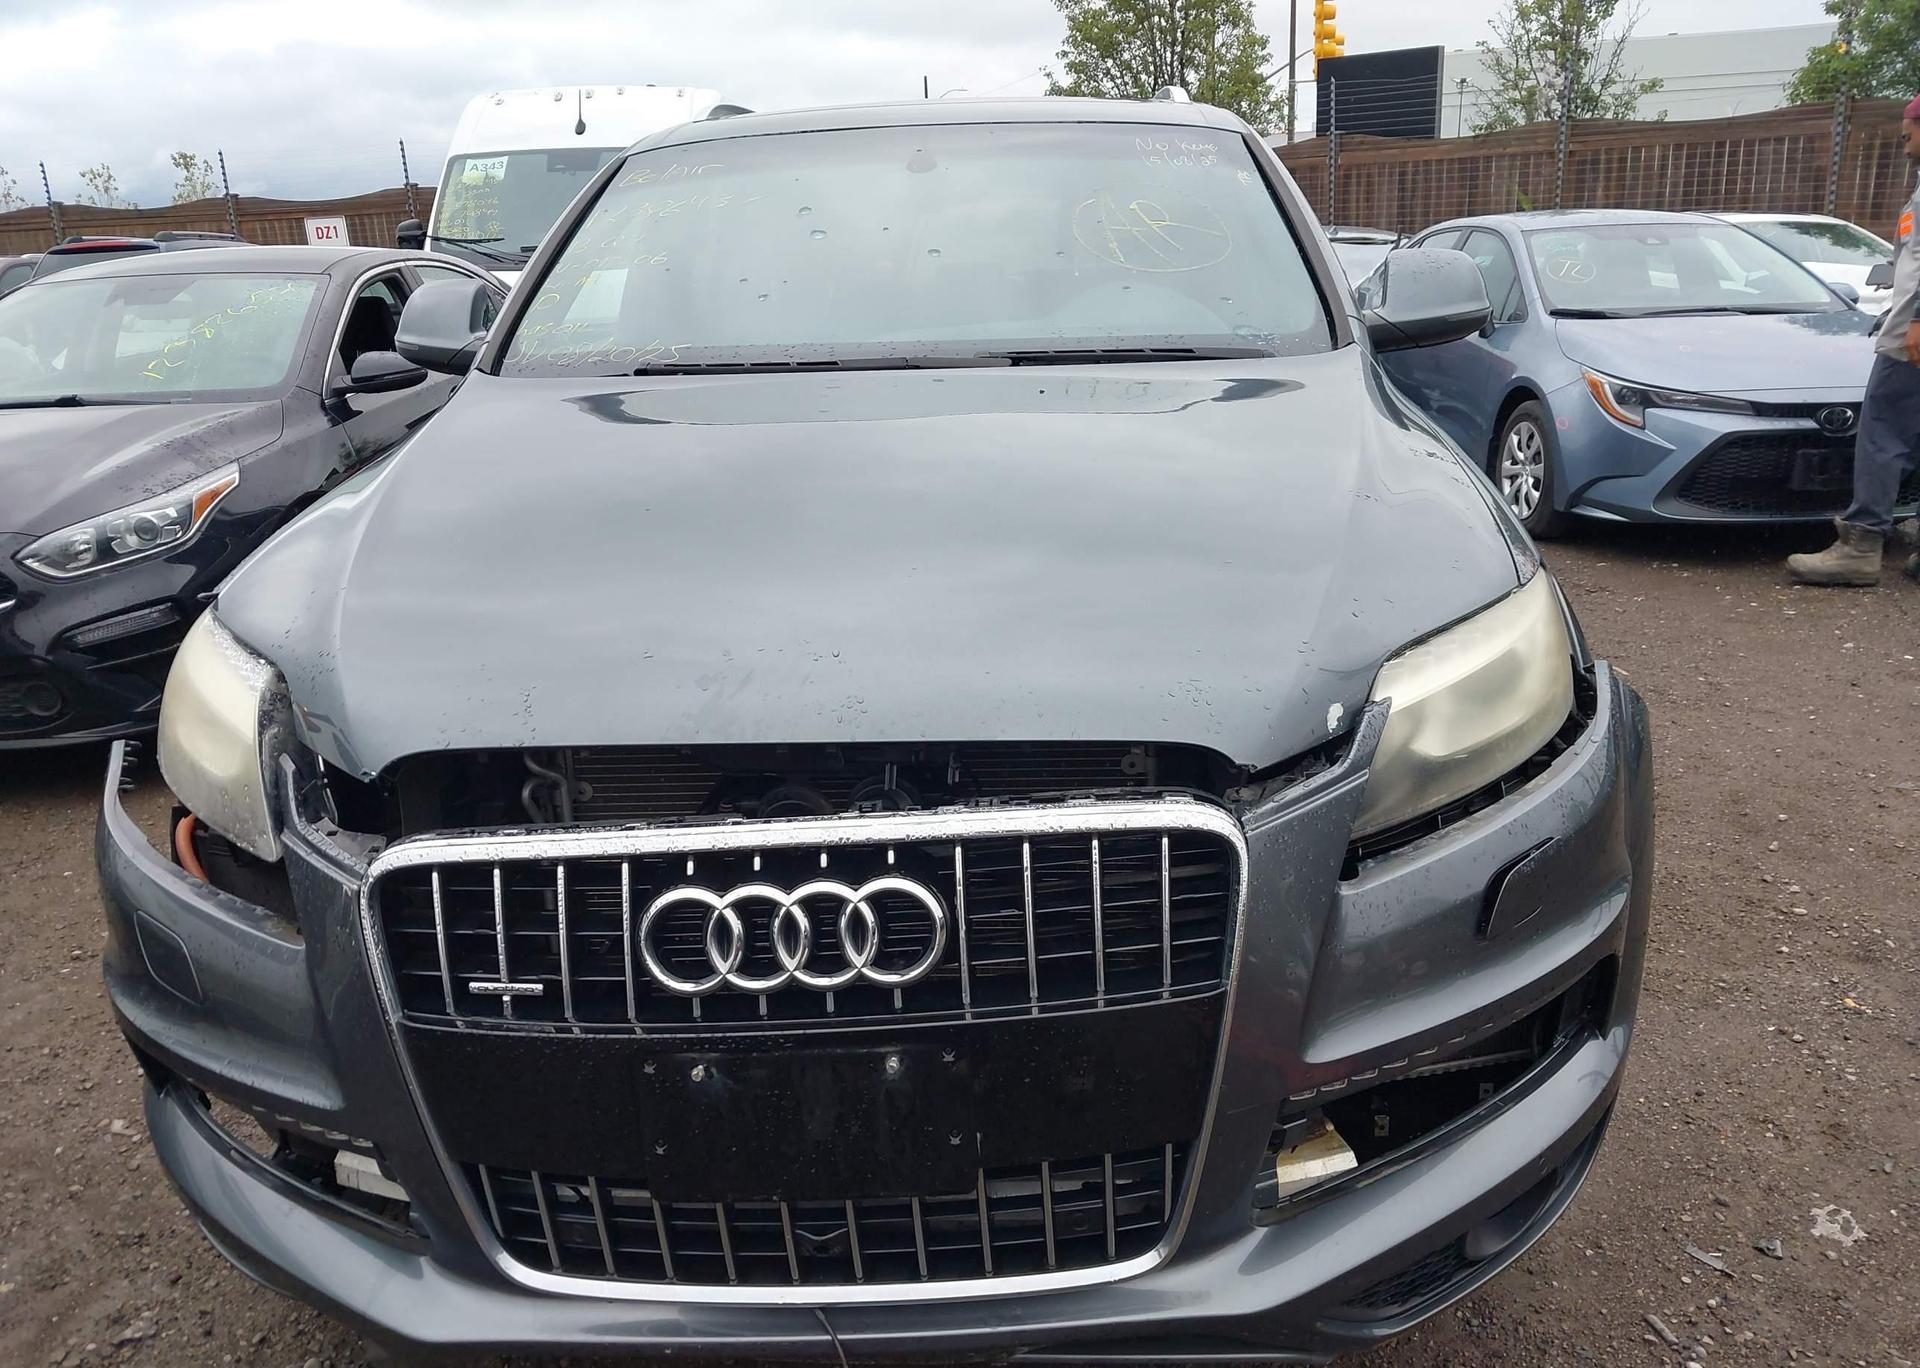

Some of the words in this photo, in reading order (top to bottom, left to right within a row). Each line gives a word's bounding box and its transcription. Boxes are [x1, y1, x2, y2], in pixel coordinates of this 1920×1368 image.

[469, 161, 505, 173] A343
[315, 225, 339, 240] DZ1
[475, 984, 538, 994] quattro
